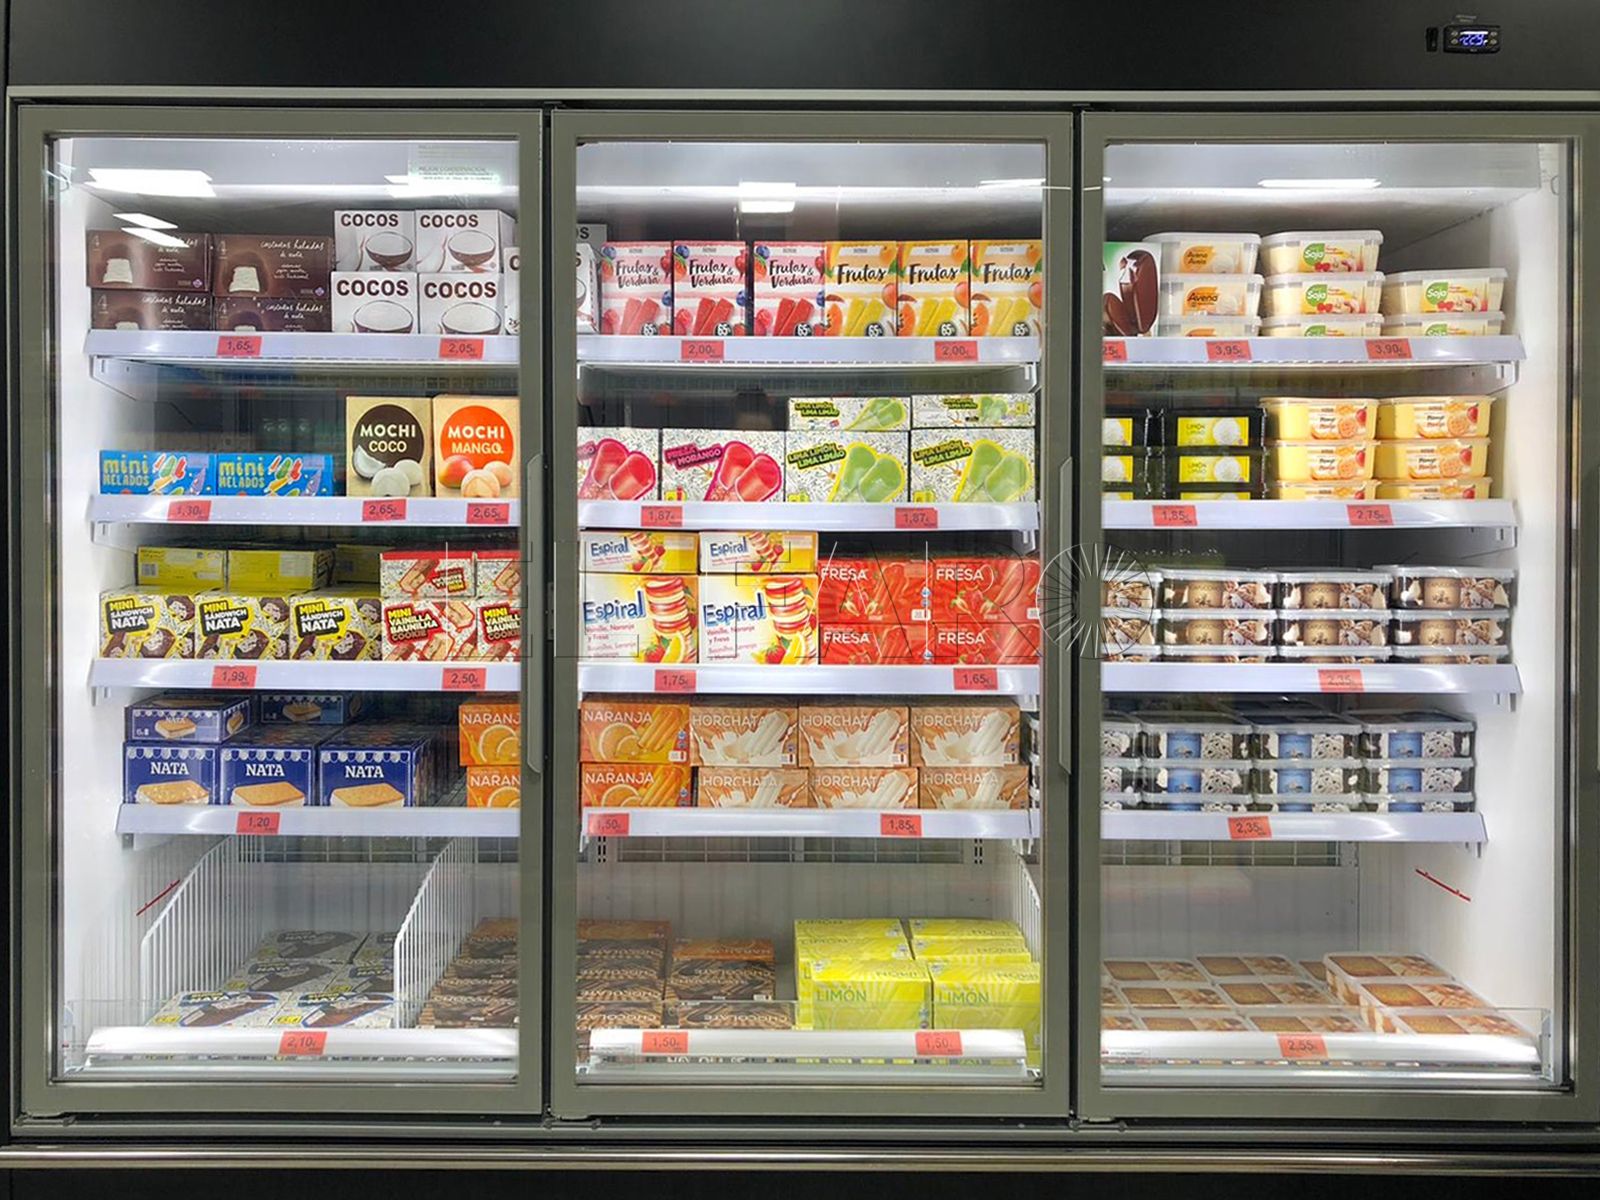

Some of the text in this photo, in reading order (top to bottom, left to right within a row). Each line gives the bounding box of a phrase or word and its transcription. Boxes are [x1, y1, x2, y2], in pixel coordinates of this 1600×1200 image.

[340, 213, 399, 228] COCOS
[419, 213, 479, 229] COCOS
[616, 260, 653, 276] Frutas
[689, 260, 726, 276] Frutas
[770, 260, 807, 276] Frutas
[837, 264, 887, 285] Frutas
[908, 264, 959, 285] Frutas
[983, 262, 1034, 285] Frutas
[336, 279, 409, 297] COCOS
[618, 276, 660, 289] Verdura
[691, 276, 734, 289] Verdura
[771, 276, 814, 289] Verdura
[423, 281, 497, 299] COCOS
[360, 424, 416, 438] MOCHI
[448, 426, 505, 440] MOCHI
[368, 440, 407, 453] COCO
[451, 441, 504, 455] MANGO
[677, 447, 722, 465] MORANGO
[103, 454, 149, 477] mini
[219, 456, 265, 477] mini
[591, 536, 630, 557] Espiral
[710, 536, 748, 557] Espiral
[821, 568, 868, 581] FRESA
[936, 568, 984, 581] FRESA
[109, 601, 134, 611] MINI
[203, 602, 227, 613] MINI
[299, 604, 324, 615] MINI
[387, 608, 412, 618] MINI
[483, 608, 508, 618] MINI
[583, 590, 647, 624] Espiral
[703, 592, 767, 627] Espiral
[112, 616, 147, 630] NATA
[205, 617, 242, 632] NATA
[301, 619, 337, 634] NATA
[390, 613, 432, 627] VAINILLA
[391, 620, 438, 635] BAUNILHA
[823, 632, 870, 645] FRESA
[938, 632, 986, 645] FRESA
[583, 710, 653, 724] NARANJA
[692, 714, 766, 727] HORCHATA
[802, 714, 876, 727] HORCHATA
[913, 714, 989, 727] HORCHATA
[150, 762, 189, 775] NATA
[246, 763, 285, 777] NATA
[345, 765, 385, 779] NATA
[585, 769, 655, 785] NARANJA
[701, 775, 777, 788] HORCHATA
[812, 774, 885, 788] HORCHATA
[921, 773, 998, 786] HORCHATA
[816, 984, 868, 1003] LIMÓN
[938, 986, 990, 1006] LIMÓN
